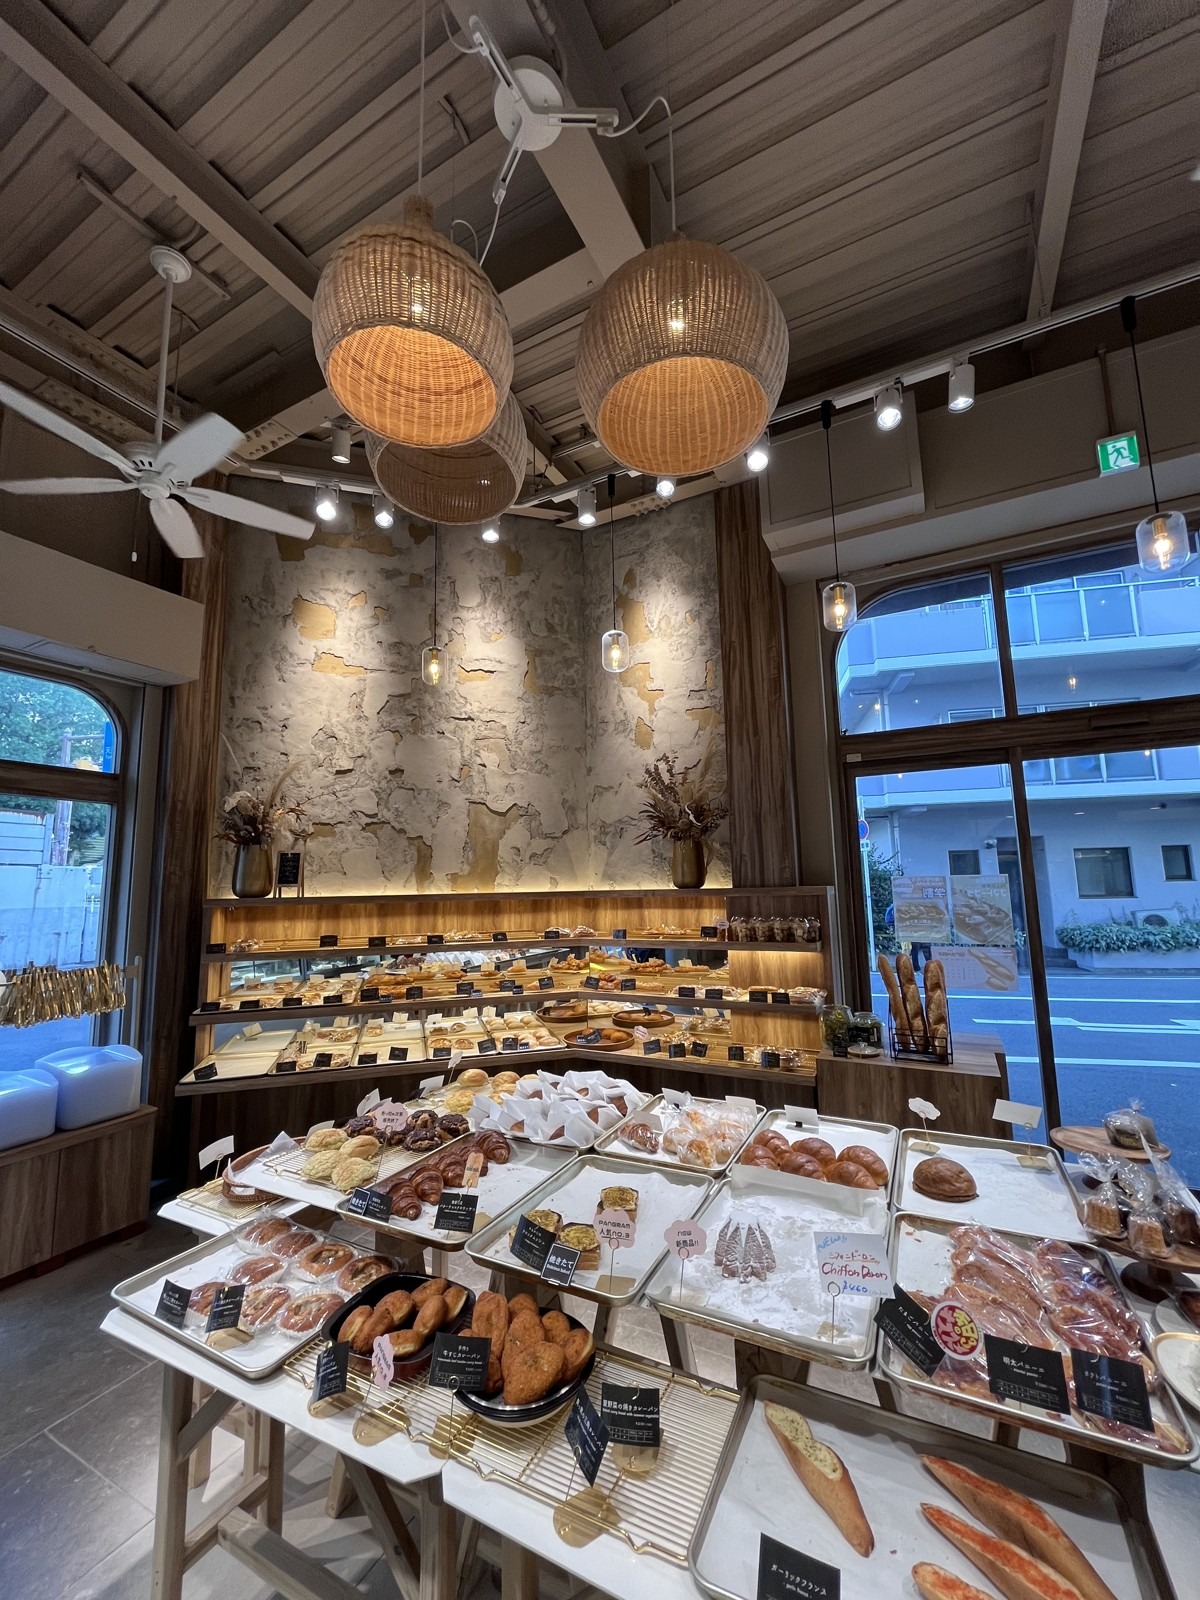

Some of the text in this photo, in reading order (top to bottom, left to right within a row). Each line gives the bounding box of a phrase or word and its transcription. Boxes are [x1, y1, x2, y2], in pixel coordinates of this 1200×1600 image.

[549, 1254, 575, 1269] 焼きたて
[821, 1262, 860, 1277] Chiffon
[443, 1350, 481, 1359] 牛すじカレーパン
[1002, 1356, 1046, 1373] 明太パニーニ
[770, 1563, 827, 1596] ガーリックフランス
